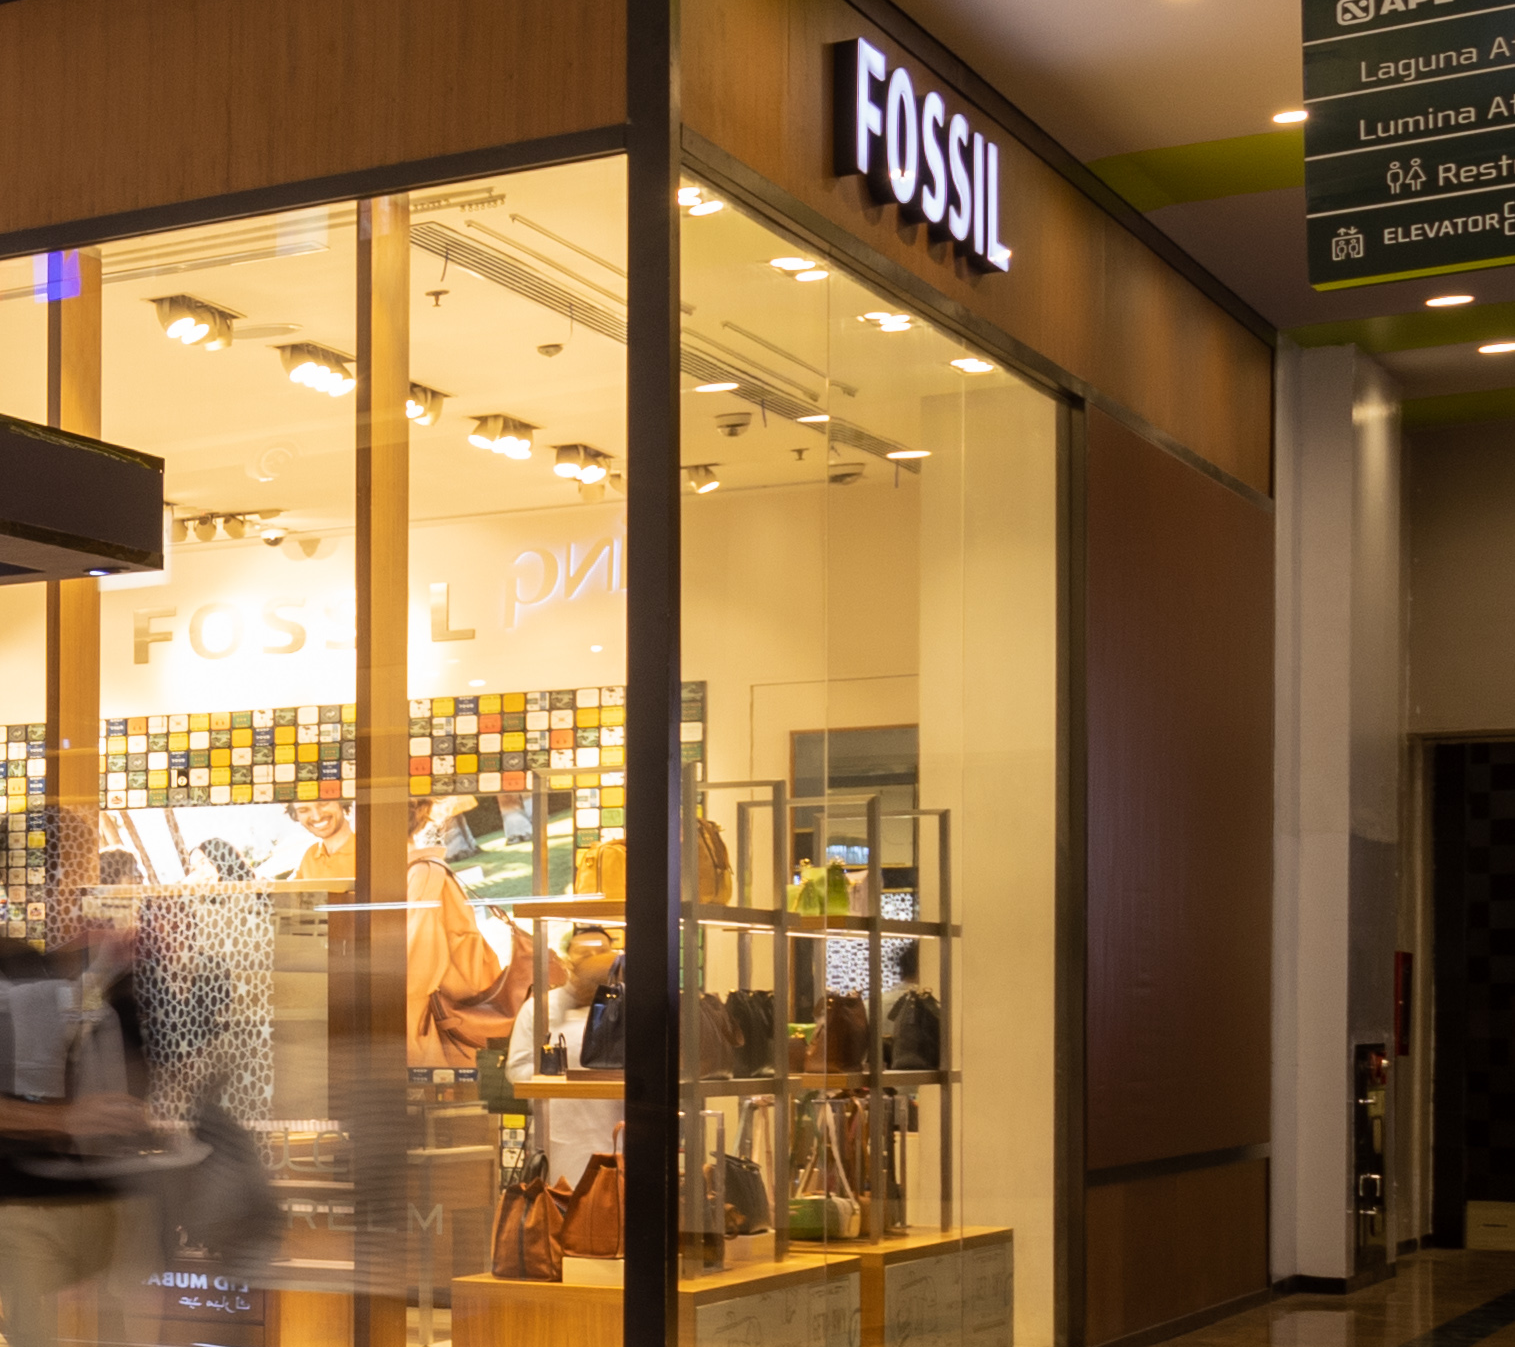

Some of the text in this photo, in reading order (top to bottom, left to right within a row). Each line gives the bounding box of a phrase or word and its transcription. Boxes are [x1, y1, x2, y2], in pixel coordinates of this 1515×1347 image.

[1360, 47, 1478, 83] Laguna
[1359, 105, 1477, 141] Lumina
[856, 36, 1013, 273] FOSSIL
[1438, 154, 1515, 187] Rest
[1383, 212, 1501, 246] ELEVATOR
